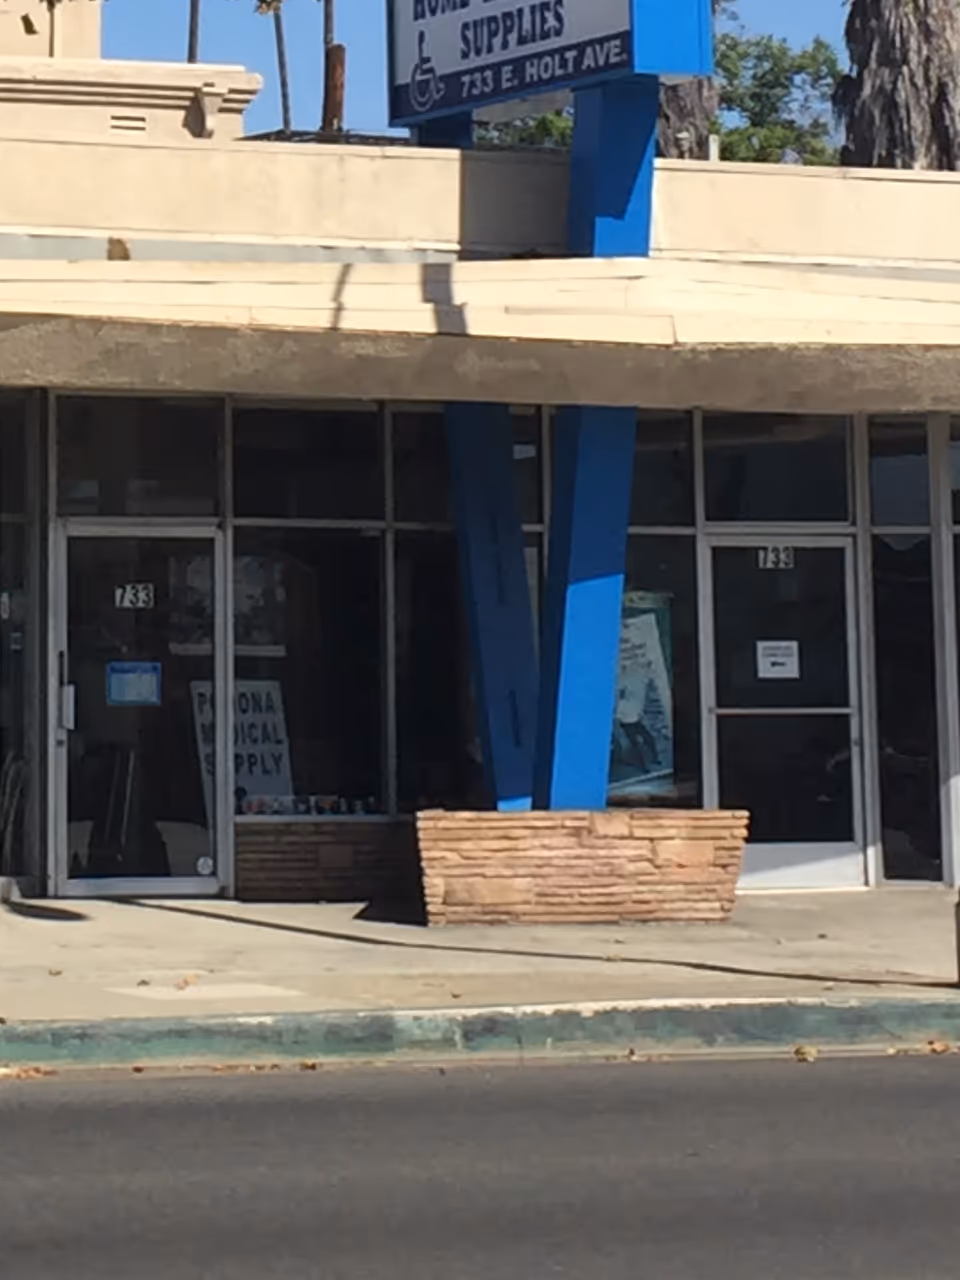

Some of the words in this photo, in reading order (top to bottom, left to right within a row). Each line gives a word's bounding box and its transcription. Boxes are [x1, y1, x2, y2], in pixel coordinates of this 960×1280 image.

[460, 70, 494, 98] 733
[501, 65, 519, 90] E.
[525, 51, 578, 84] HOLT
[581, 39, 628, 70] AVE.
[115, 584, 154, 608] 733
[197, 691, 276, 715] PONA
[204, 751, 283, 776] SPPLY
